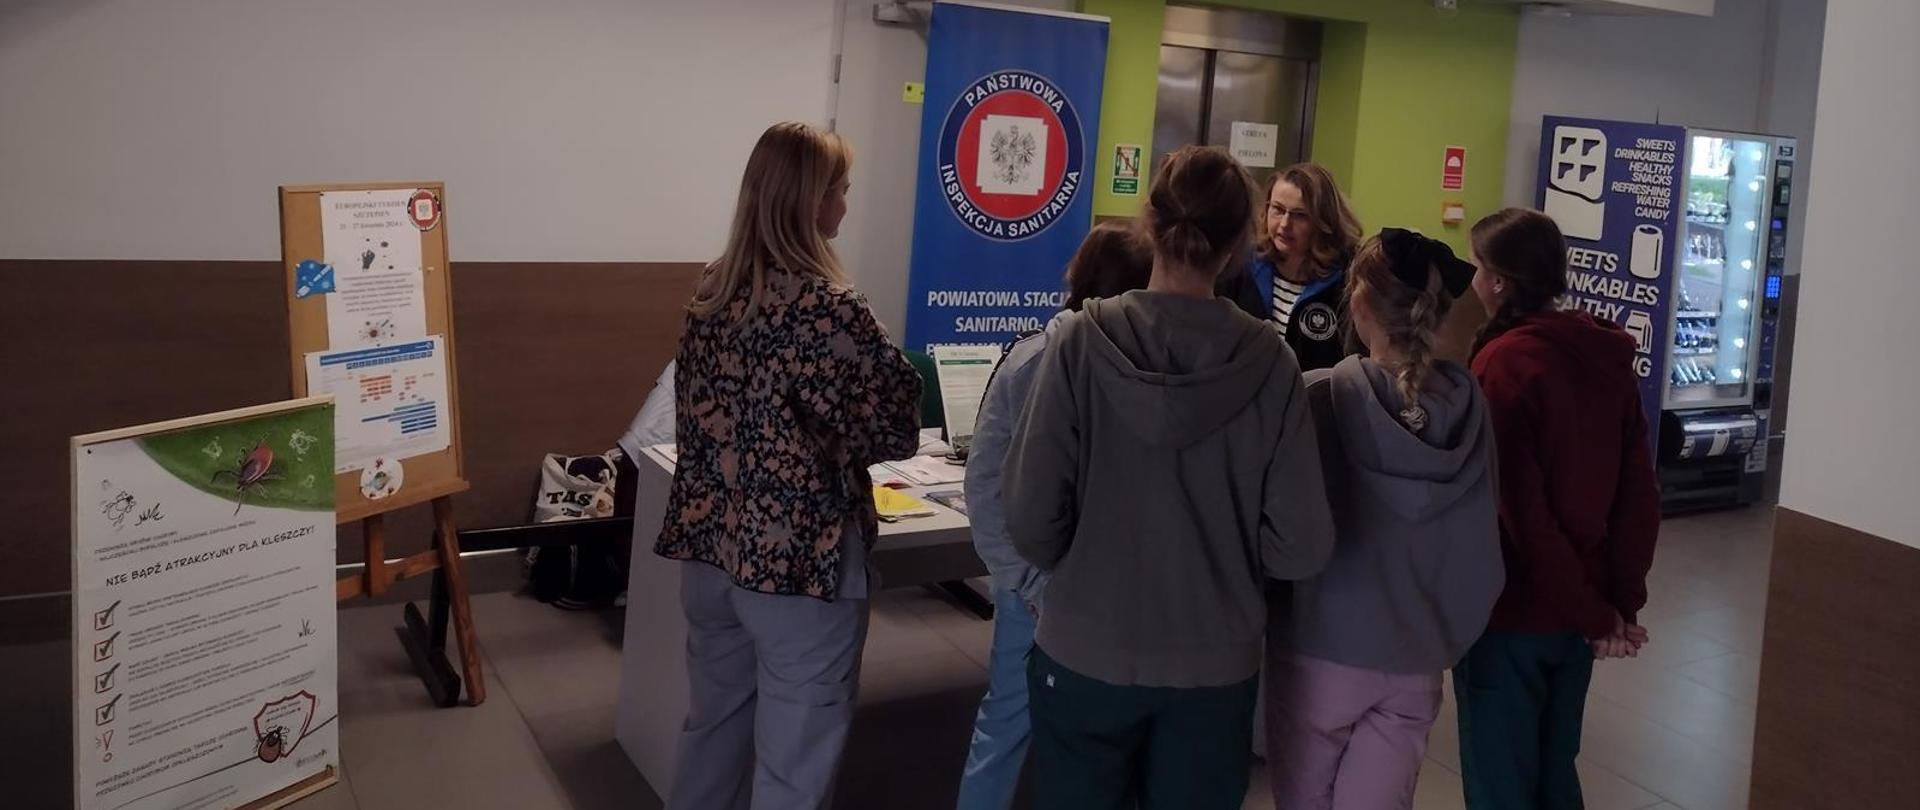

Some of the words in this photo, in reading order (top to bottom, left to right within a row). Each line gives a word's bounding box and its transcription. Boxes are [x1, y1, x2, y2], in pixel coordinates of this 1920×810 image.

[964, 74, 1064, 113] PAŃSTWOWA
[1635, 138, 1677, 152] SWEETS
[1614, 148, 1676, 164] DRINKABLES
[1628, 161, 1675, 176] HEALTHY
[1631, 172, 1673, 186] SNACKS
[1611, 181, 1671, 198] REFRESHING
[941, 163, 1004, 237] INSPEKCJA
[1008, 170, 1080, 237] SANITARNA
[1636, 195, 1671, 209] WATER
[1634, 207, 1670, 221] CANDY
[1567, 246, 1619, 273] EETS
[927, 290, 1020, 307] POWIATOWA
[1023, 291, 1067, 307] STACJ
[954, 316, 1043, 332] SANITARNO-
[105, 574, 127, 587] NIE
[131, 564, 162, 581] BĄDŹ
[165, 545, 236, 571] ATRAKCYJNY
[238, 541, 259, 553] DLA
[261, 525, 316, 546] KLESZCZY!
